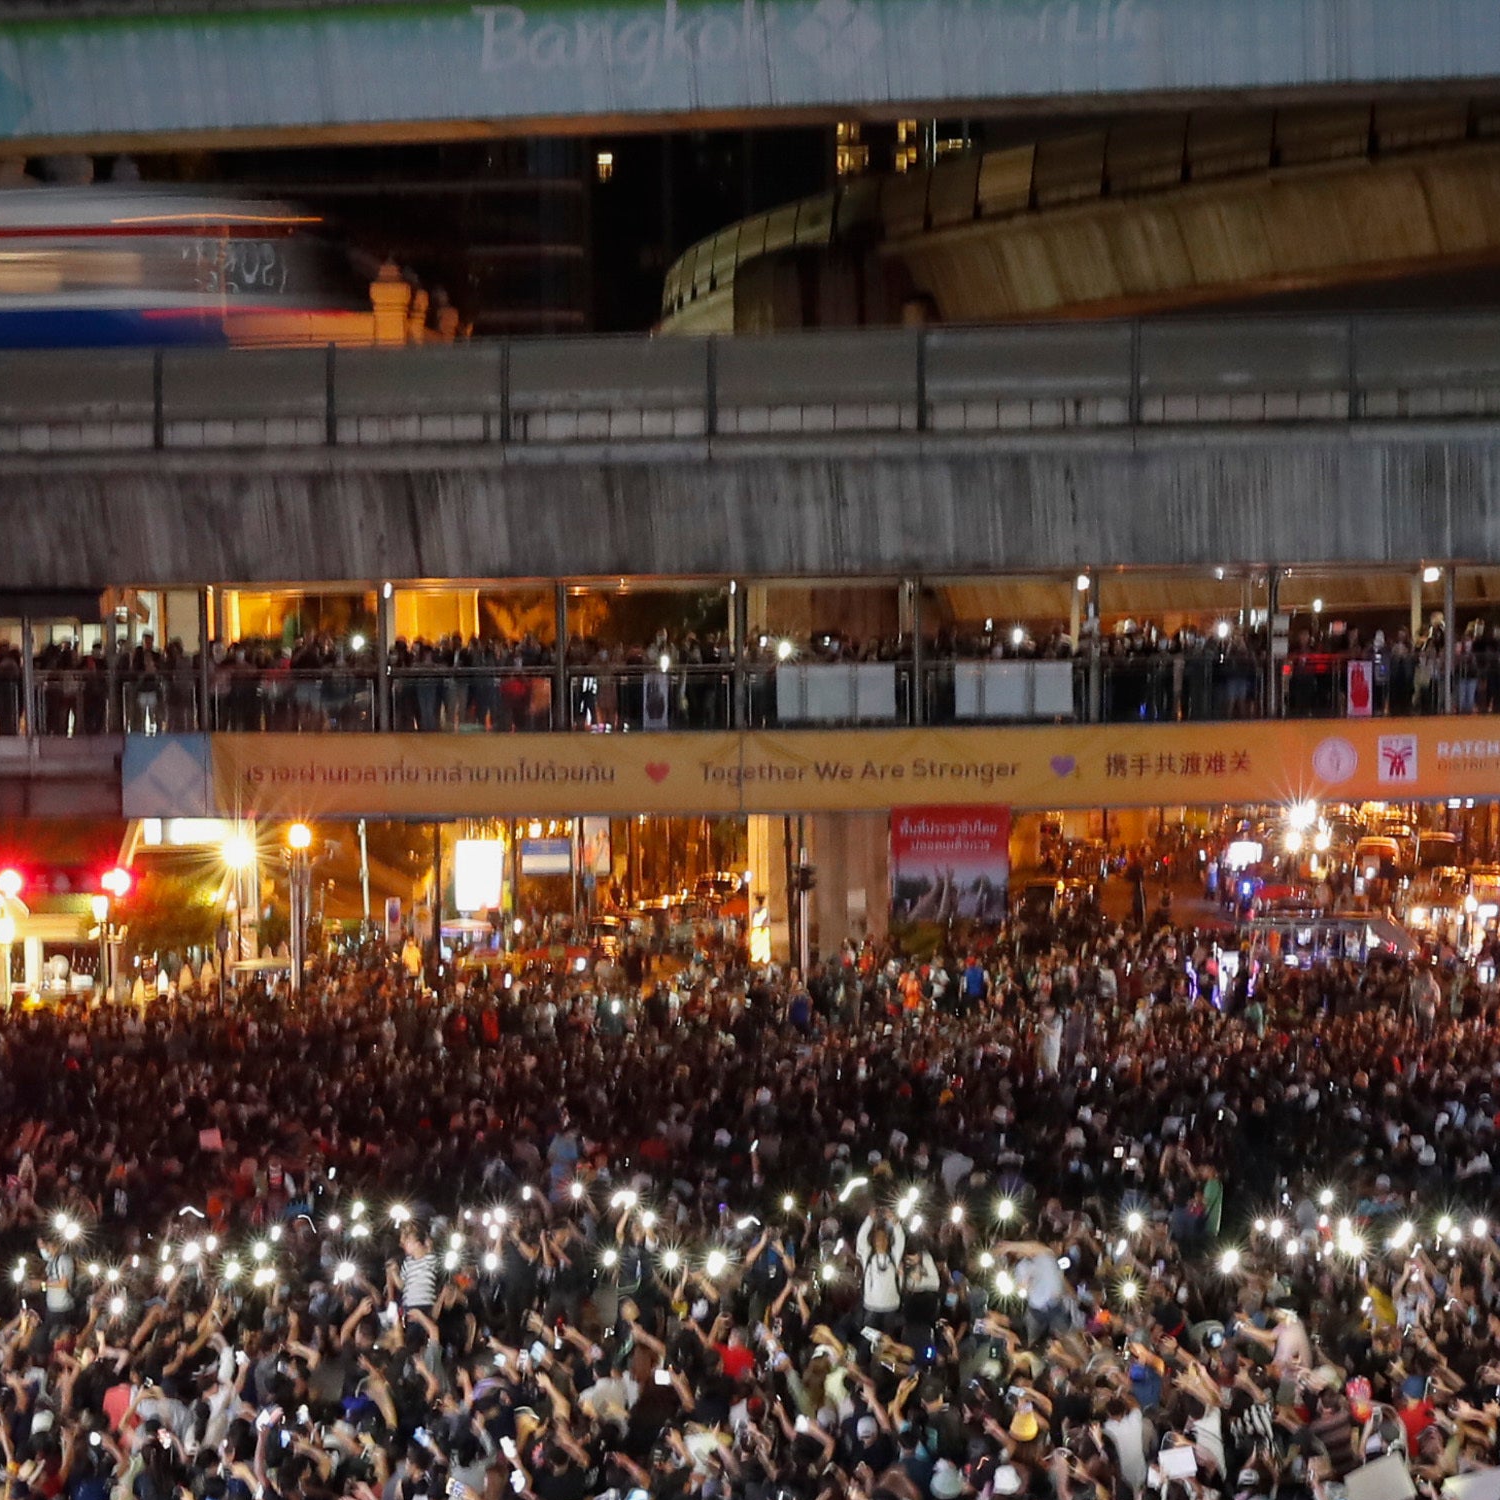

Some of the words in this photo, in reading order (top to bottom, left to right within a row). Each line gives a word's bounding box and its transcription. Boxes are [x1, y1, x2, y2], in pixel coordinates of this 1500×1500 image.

[700, 761, 805, 787] Together
[814, 760, 851, 781] We
[860, 759, 904, 780] Are
[912, 757, 1021, 787] Stronger
[1105, 748, 1251, 777] 携手共渡难关
